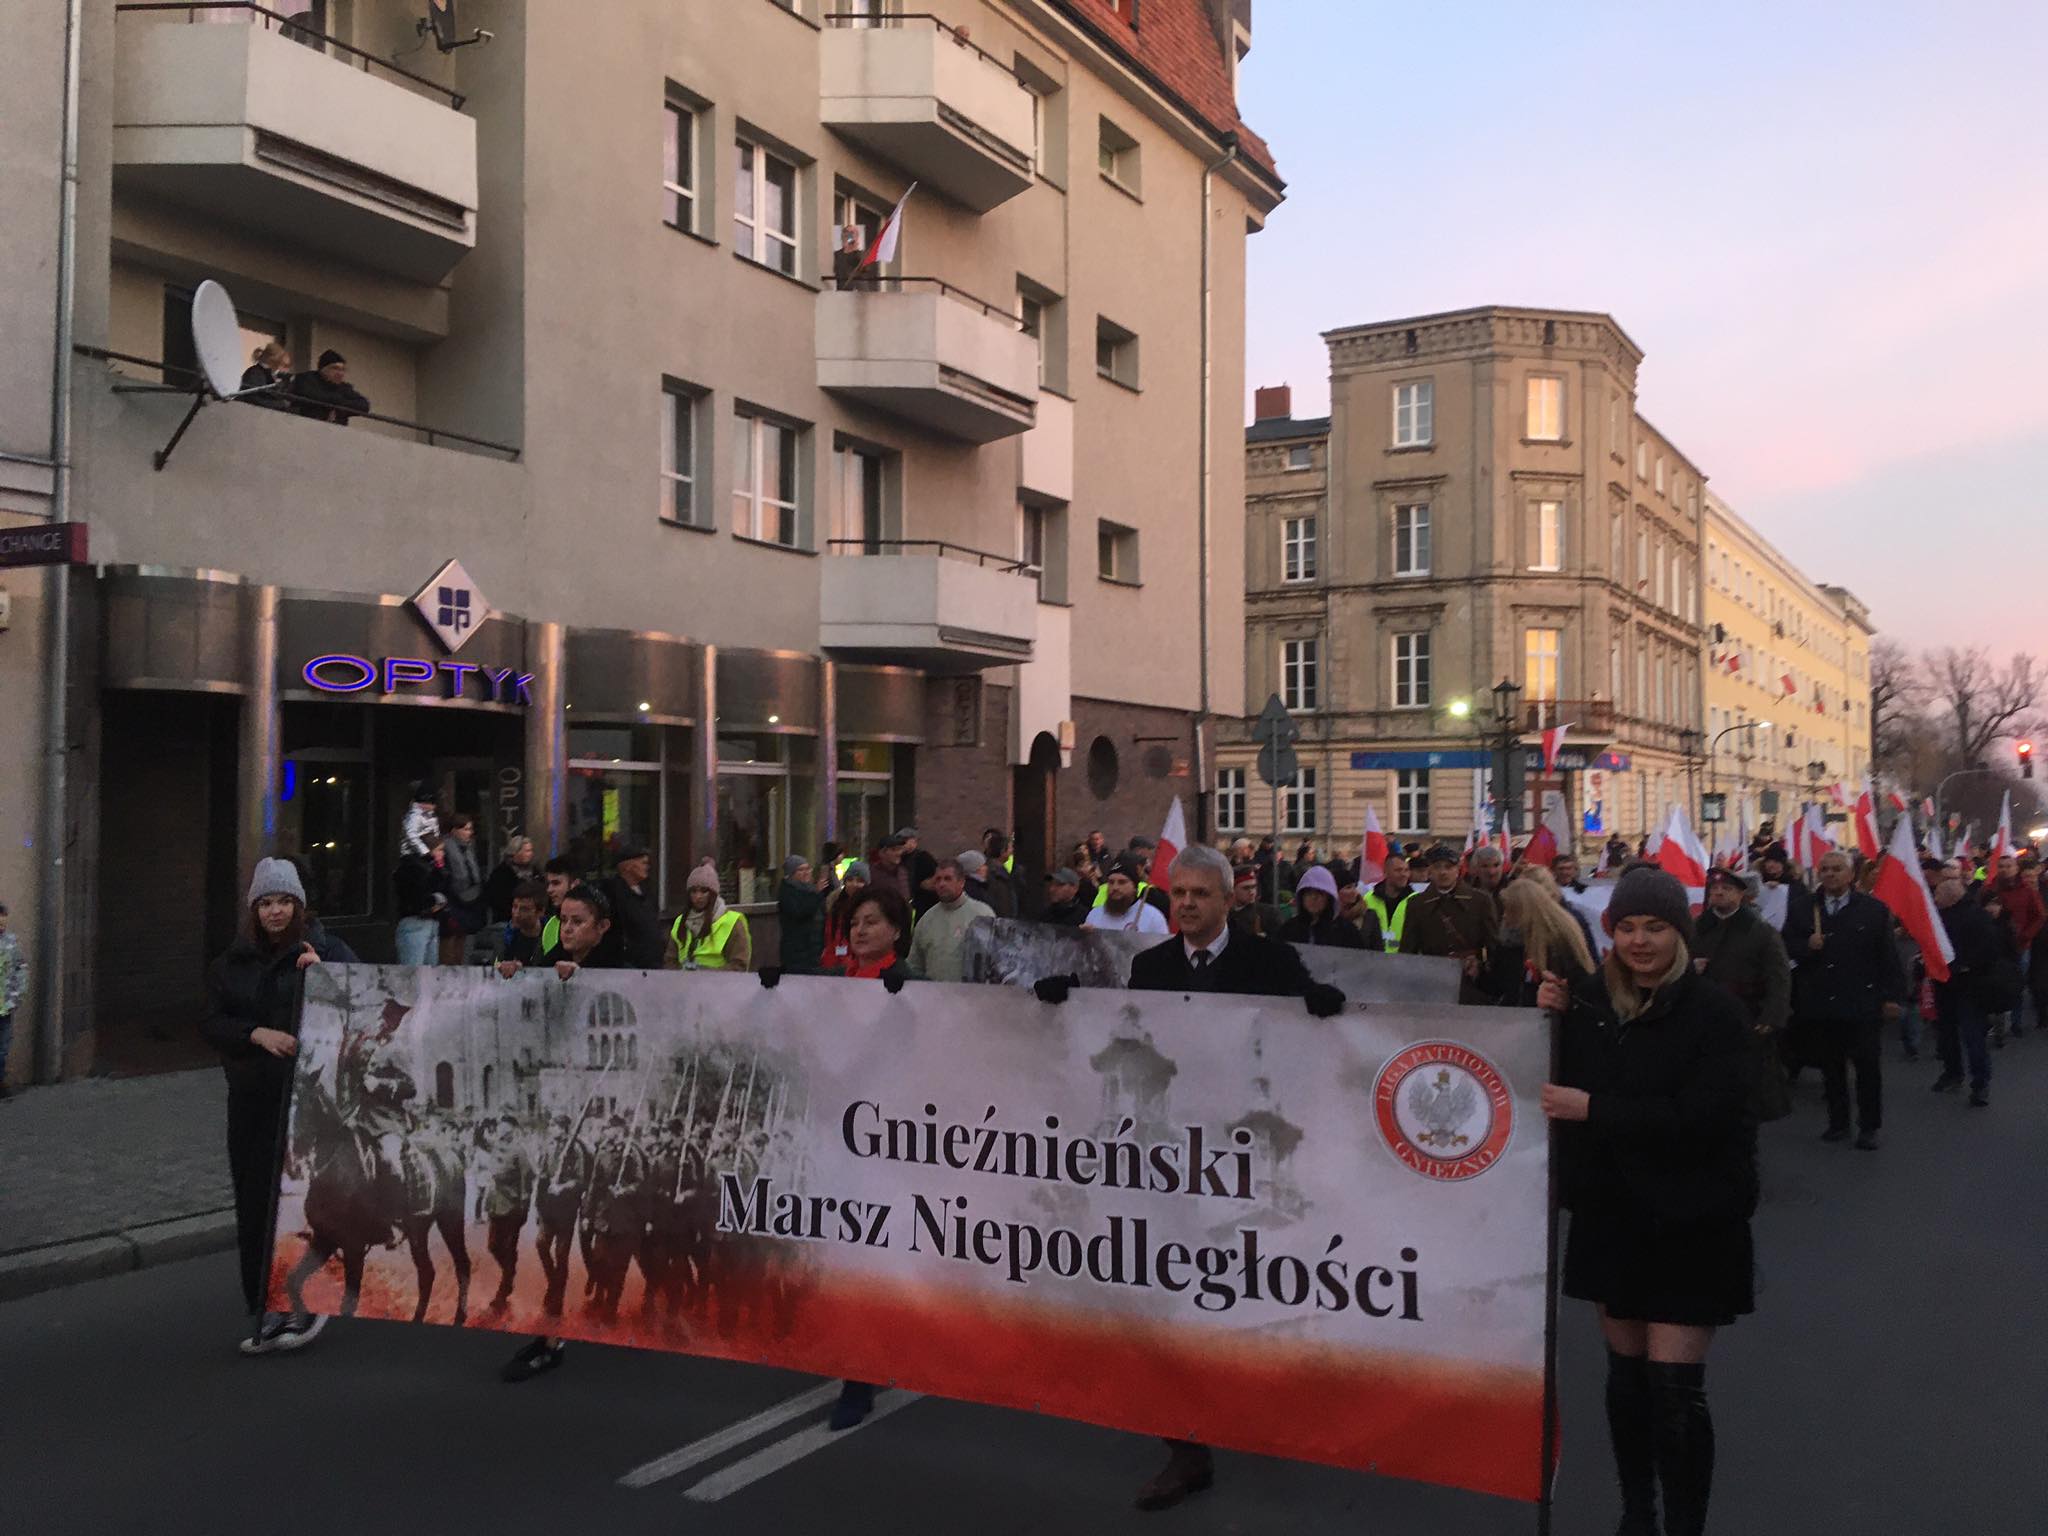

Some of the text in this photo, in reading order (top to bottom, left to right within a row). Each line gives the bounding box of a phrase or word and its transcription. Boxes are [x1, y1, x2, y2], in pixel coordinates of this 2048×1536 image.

[303, 654, 536, 706] OPTYK
[1378, 1060, 1410, 1101] LIGA
[841, 1100, 1256, 1200] Gnieźnieński
[716, 1174, 1424, 1321] Marsz Niepodległości
